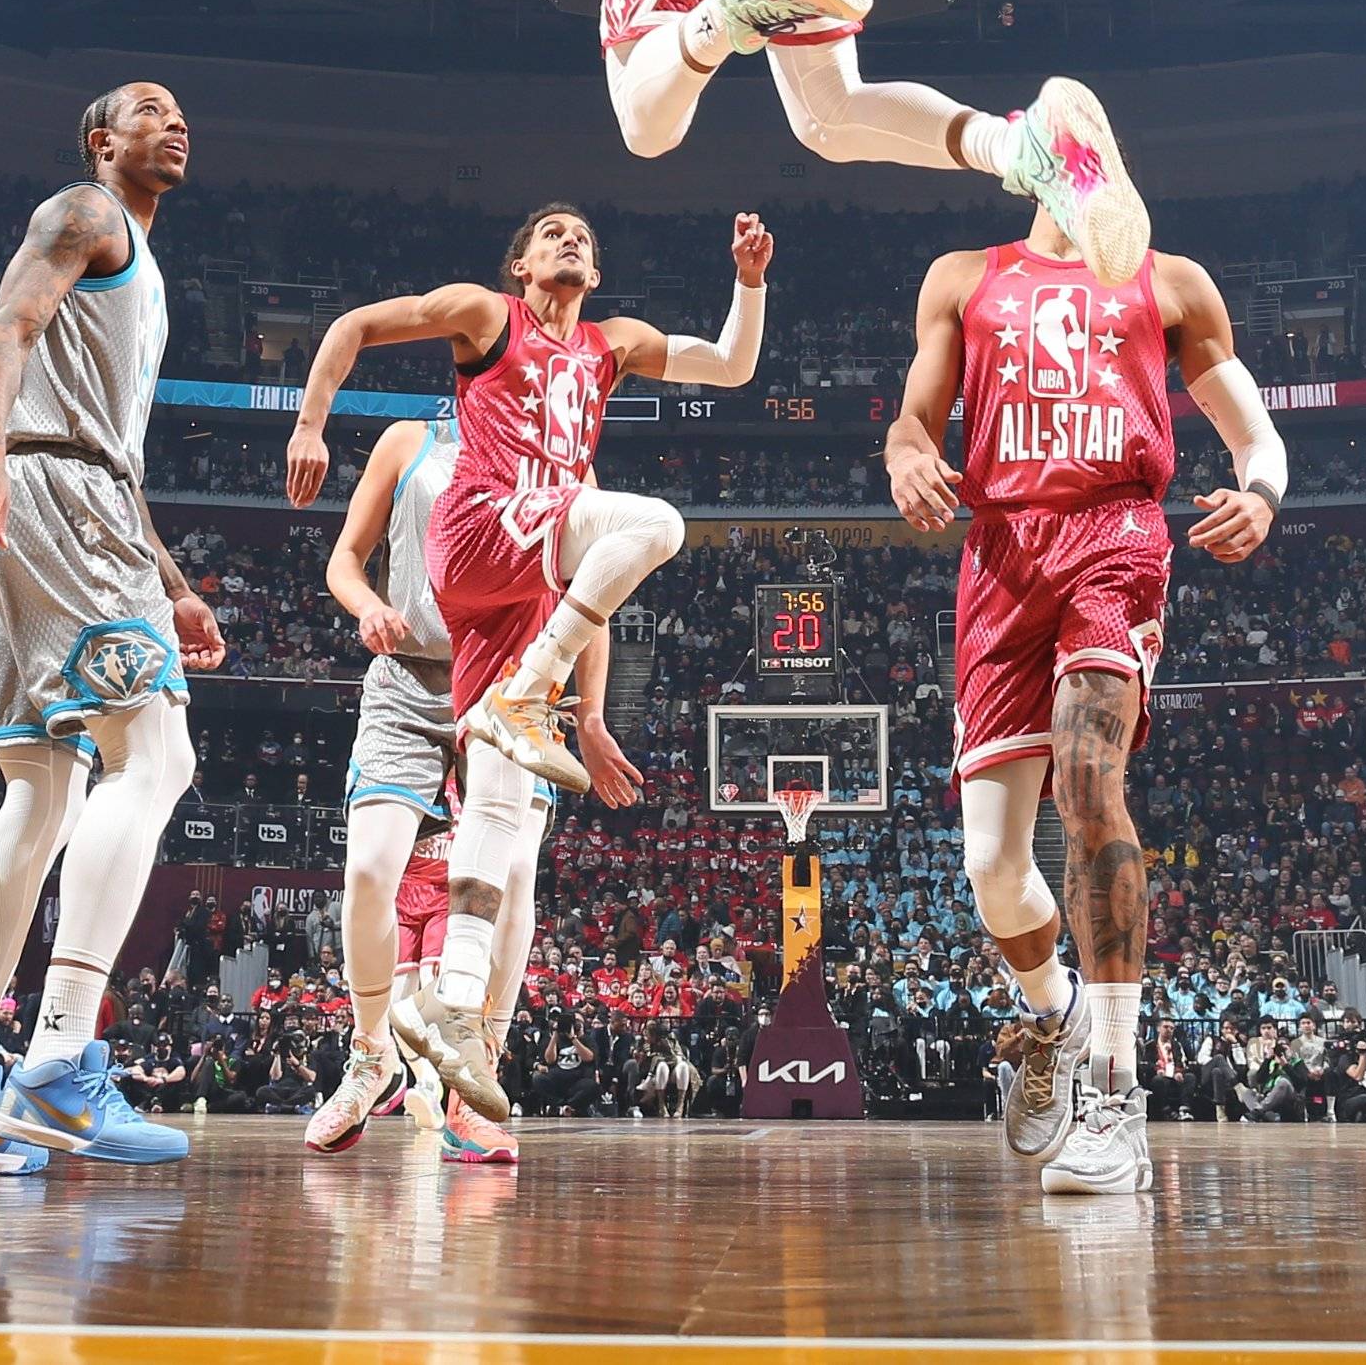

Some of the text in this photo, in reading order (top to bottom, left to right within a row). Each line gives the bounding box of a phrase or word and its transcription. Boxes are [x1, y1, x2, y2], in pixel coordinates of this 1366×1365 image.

[1037, 369, 1065, 389] NBA
[250, 385, 281, 409] TEAM
[1290, 383, 1336, 408] DURANT
[678, 401, 715, 418] 1ST
[765, 398, 814, 420] 7:56
[997, 402, 1126, 463] ALL-STAR
[550, 435, 569, 459] NBA
[782, 592, 825, 612] 7:56
[773, 613, 821, 652] 20
[783, 657, 832, 668] TISSOT
[188, 823, 212, 836] tbs
[261, 826, 285, 840] tbs
[758, 1060, 845, 1084] KIA
